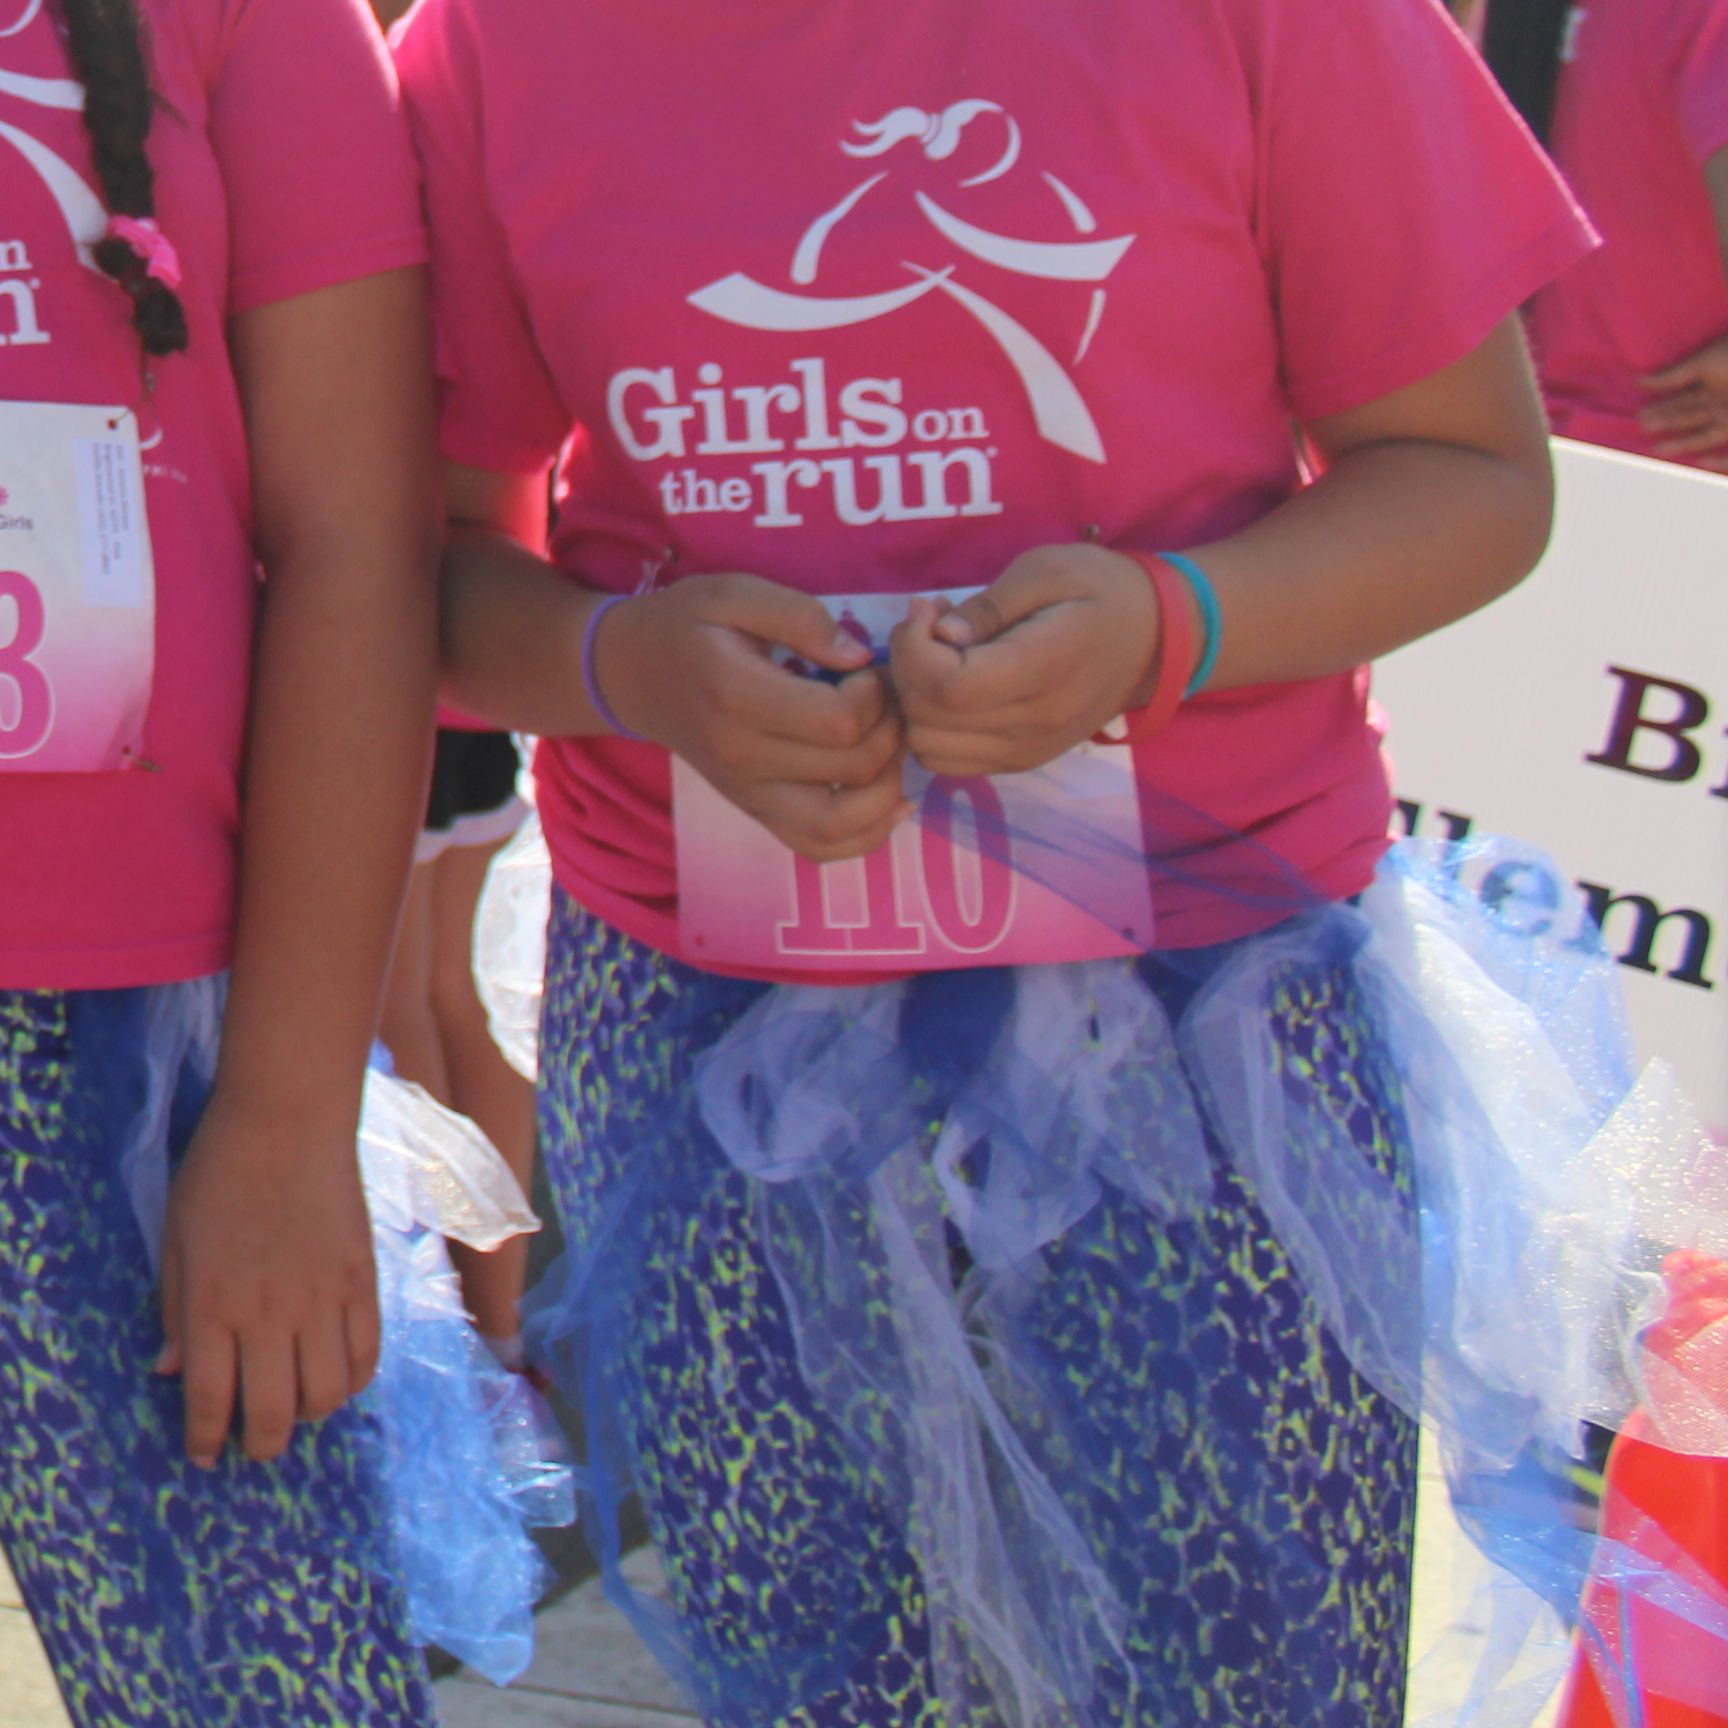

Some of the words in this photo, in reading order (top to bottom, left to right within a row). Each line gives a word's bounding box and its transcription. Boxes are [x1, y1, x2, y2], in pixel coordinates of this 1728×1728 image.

[607, 357, 908, 462] Girls
[912, 406, 990, 441] on
[659, 468, 752, 515] the
[751, 446, 1004, 528] run
